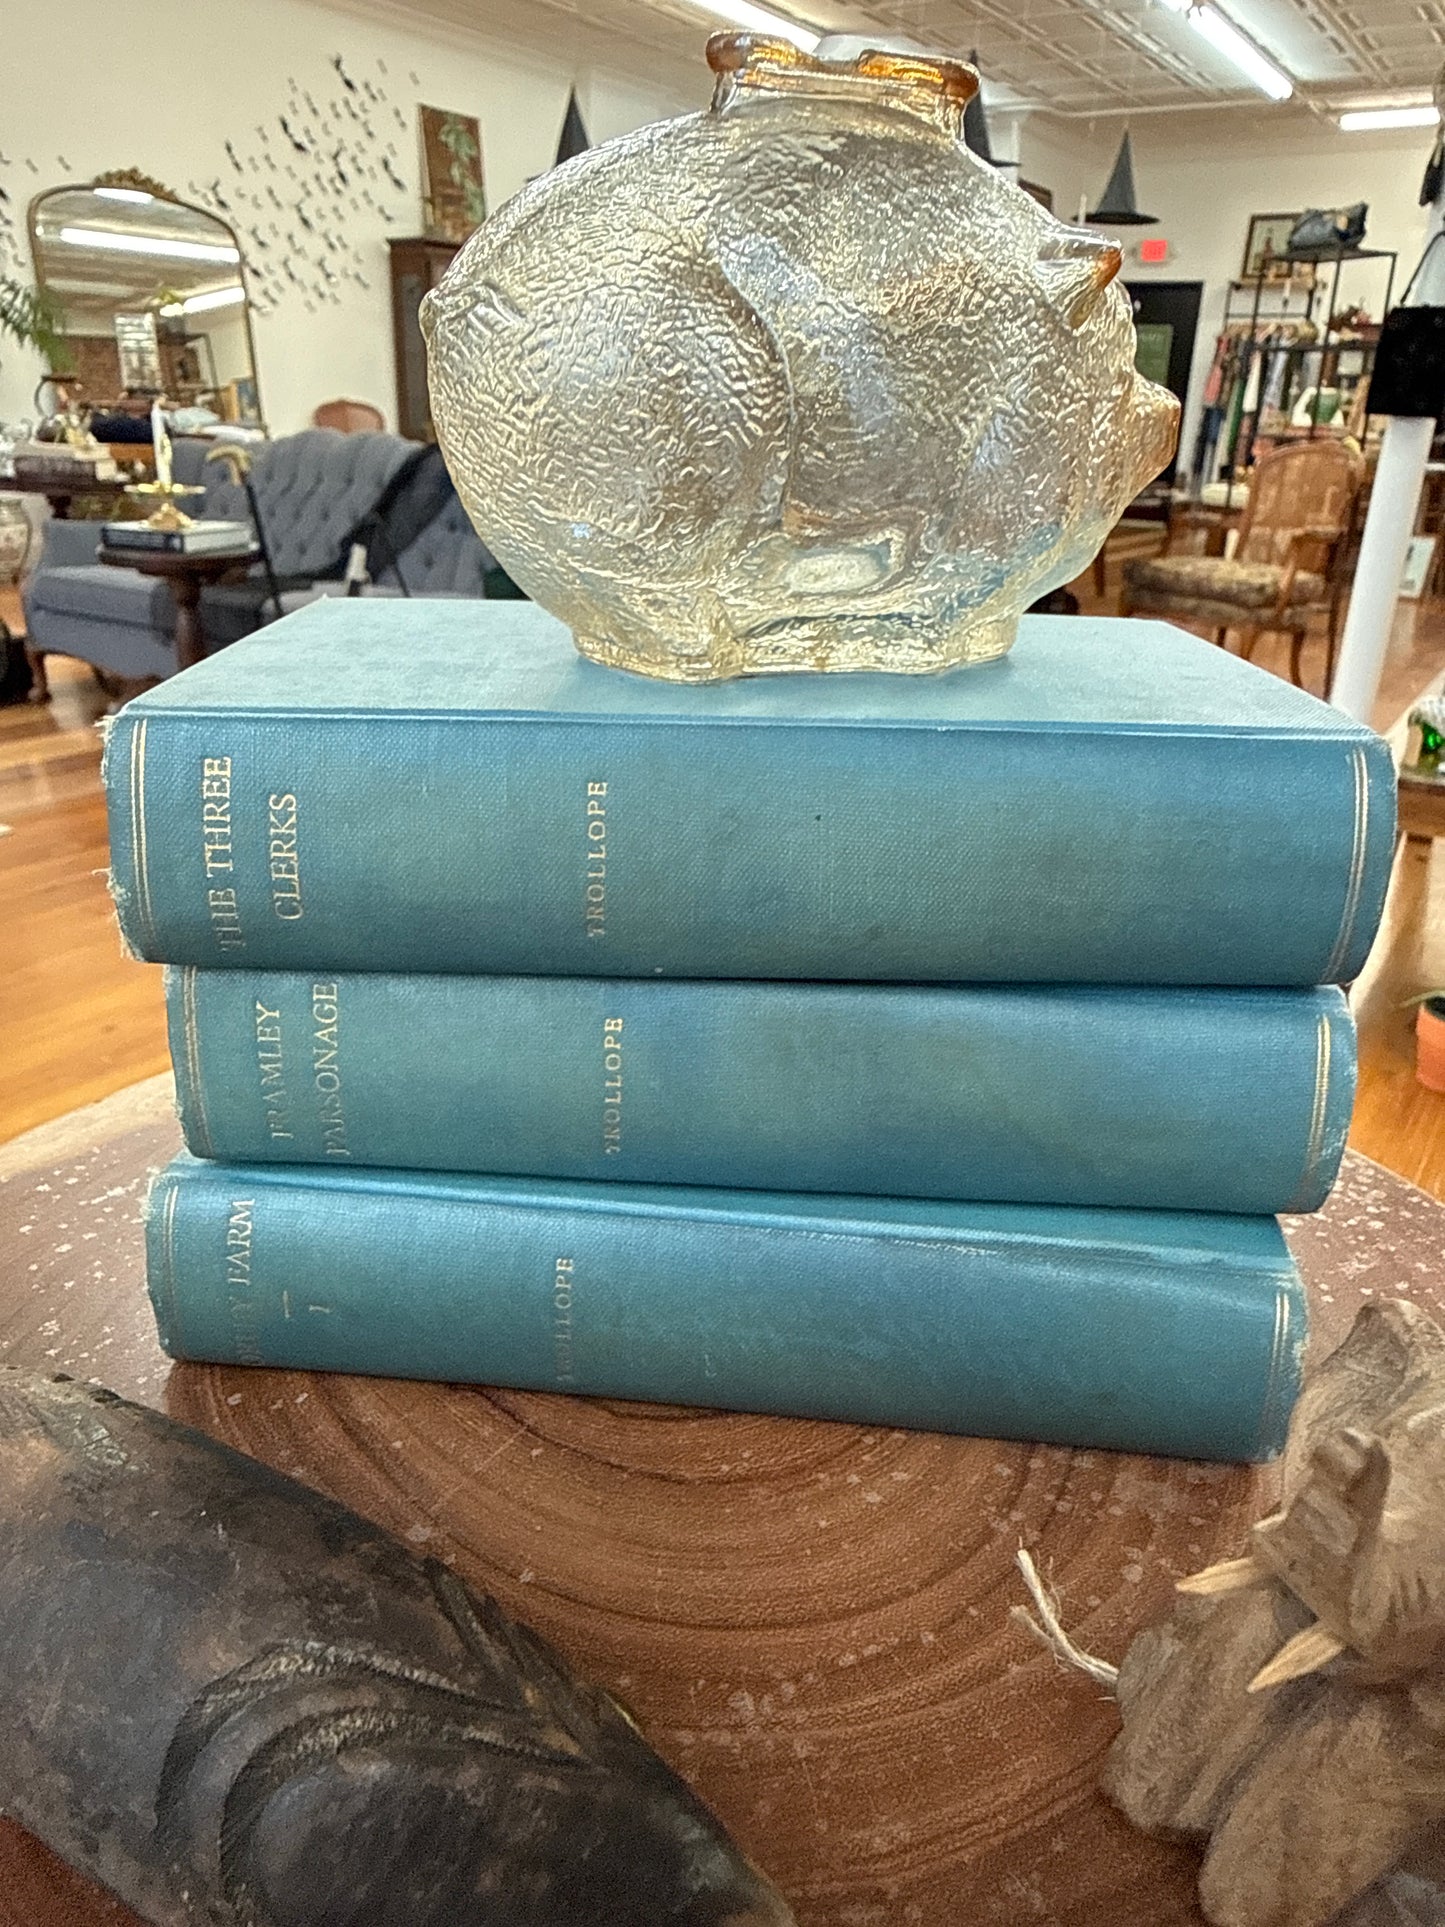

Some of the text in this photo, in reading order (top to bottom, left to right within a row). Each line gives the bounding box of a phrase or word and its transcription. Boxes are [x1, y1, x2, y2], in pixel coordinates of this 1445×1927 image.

[202, 755, 247, 952] THE THREE
[268, 792, 304, 921] CLERKS
[586, 781, 609, 939] TROLLOPE
[255, 999, 295, 1140] FRAMLEY
[312, 982, 351, 1157] PARSONAGE
[603, 1017, 624, 1156] TROLLOPE
[225, 1198, 256, 1287] FARM
[554, 1257, 575, 1382] TOLLOPE
